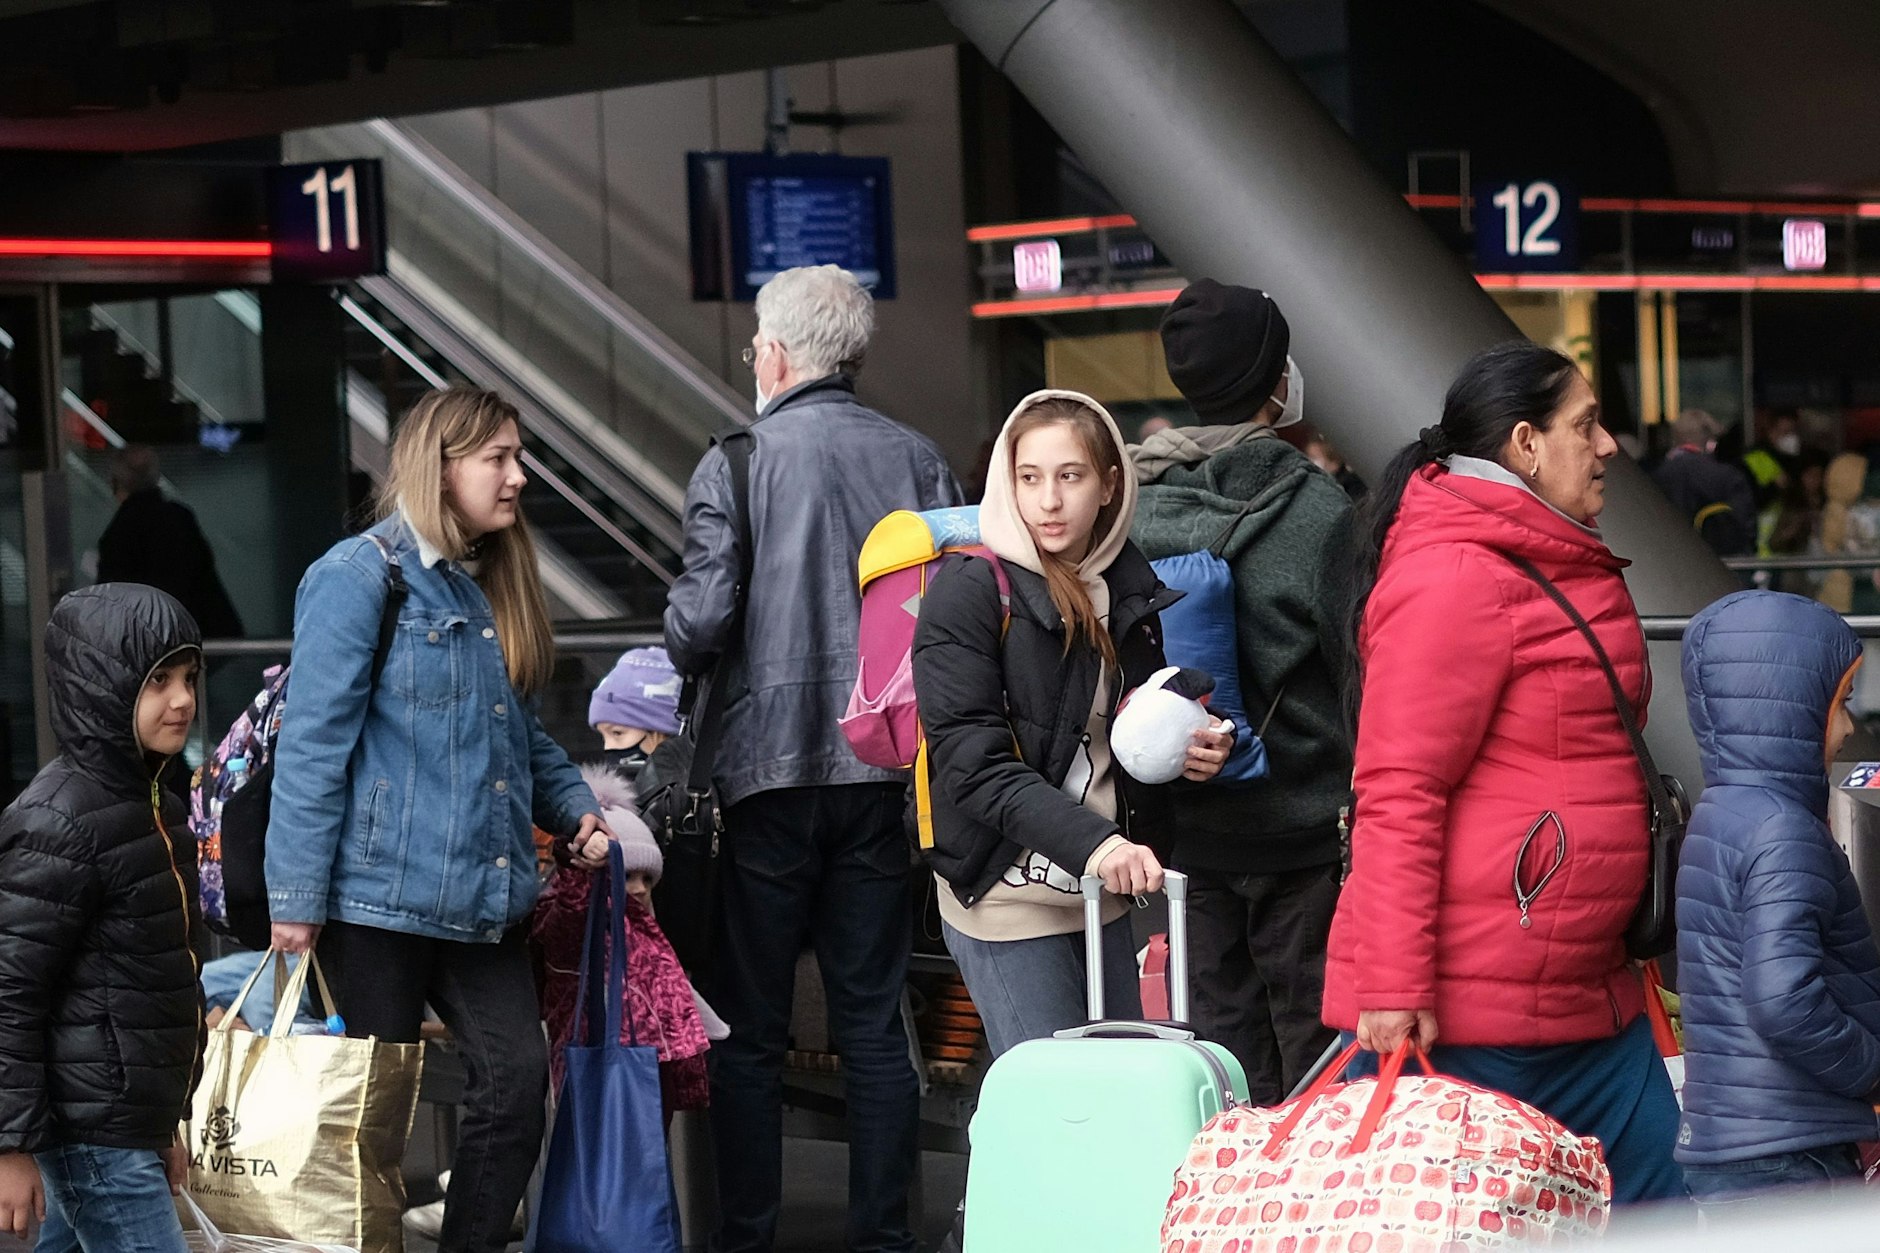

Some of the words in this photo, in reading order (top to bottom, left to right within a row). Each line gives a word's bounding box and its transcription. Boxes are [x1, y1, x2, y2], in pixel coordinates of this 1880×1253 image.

[302, 166, 359, 252] 11
[1492, 182, 1561, 255] 12
[210, 1154, 278, 1177] VISTA
[190, 1182, 240, 1198] Collection
